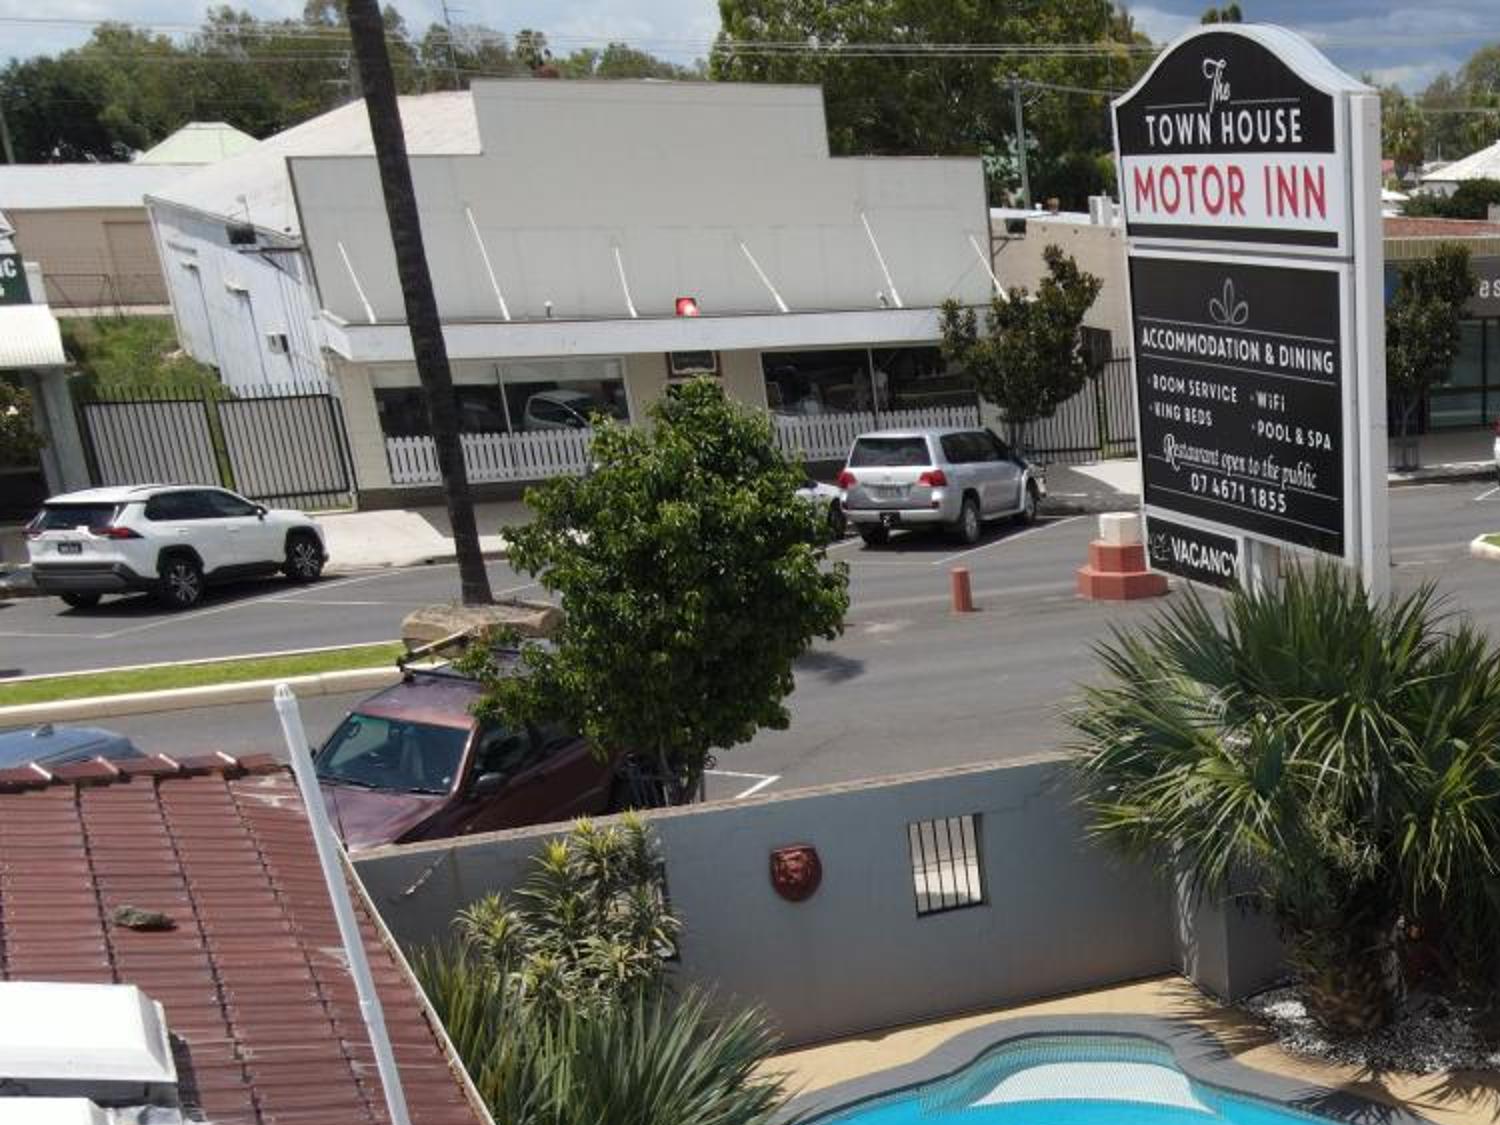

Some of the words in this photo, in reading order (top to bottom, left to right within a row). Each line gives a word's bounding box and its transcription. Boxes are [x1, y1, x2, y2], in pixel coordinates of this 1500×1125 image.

[1202, 58, 1231, 113] The
[1145, 112, 1212, 147] TOWN
[1221, 108, 1303, 144] HOUSE
[1134, 164, 1247, 217] MOTOR
[1264, 164, 1327, 221] INN
[1142, 327, 1260, 363] ACCOMMODATION
[1265, 342, 1275, 366] &
[1279, 345, 1334, 374] DINING
[1153, 373, 1185, 394] ROOM
[1189, 379, 1238, 403] SERVICE
[1256, 390, 1286, 413] WiFi
[1154, 401, 1181, 421] KING
[1184, 407, 1213, 427] BEDS
[1257, 420, 1291, 443] POOL
[1295, 428, 1305, 445] &
[1307, 430, 1332, 450] SPA
[1163, 433, 1219, 472] Restaurant
[1221, 453, 1246, 477] open
[1248, 456, 1261, 476] to
[1262, 454, 1281, 480] the
[1281, 460, 1317, 490] public
[1191, 472, 1207, 493] 07
[1212, 477, 1245, 503] 4671
[1250, 486, 1287, 513] 1855
[1170, 536, 1240, 579] VACANCY
